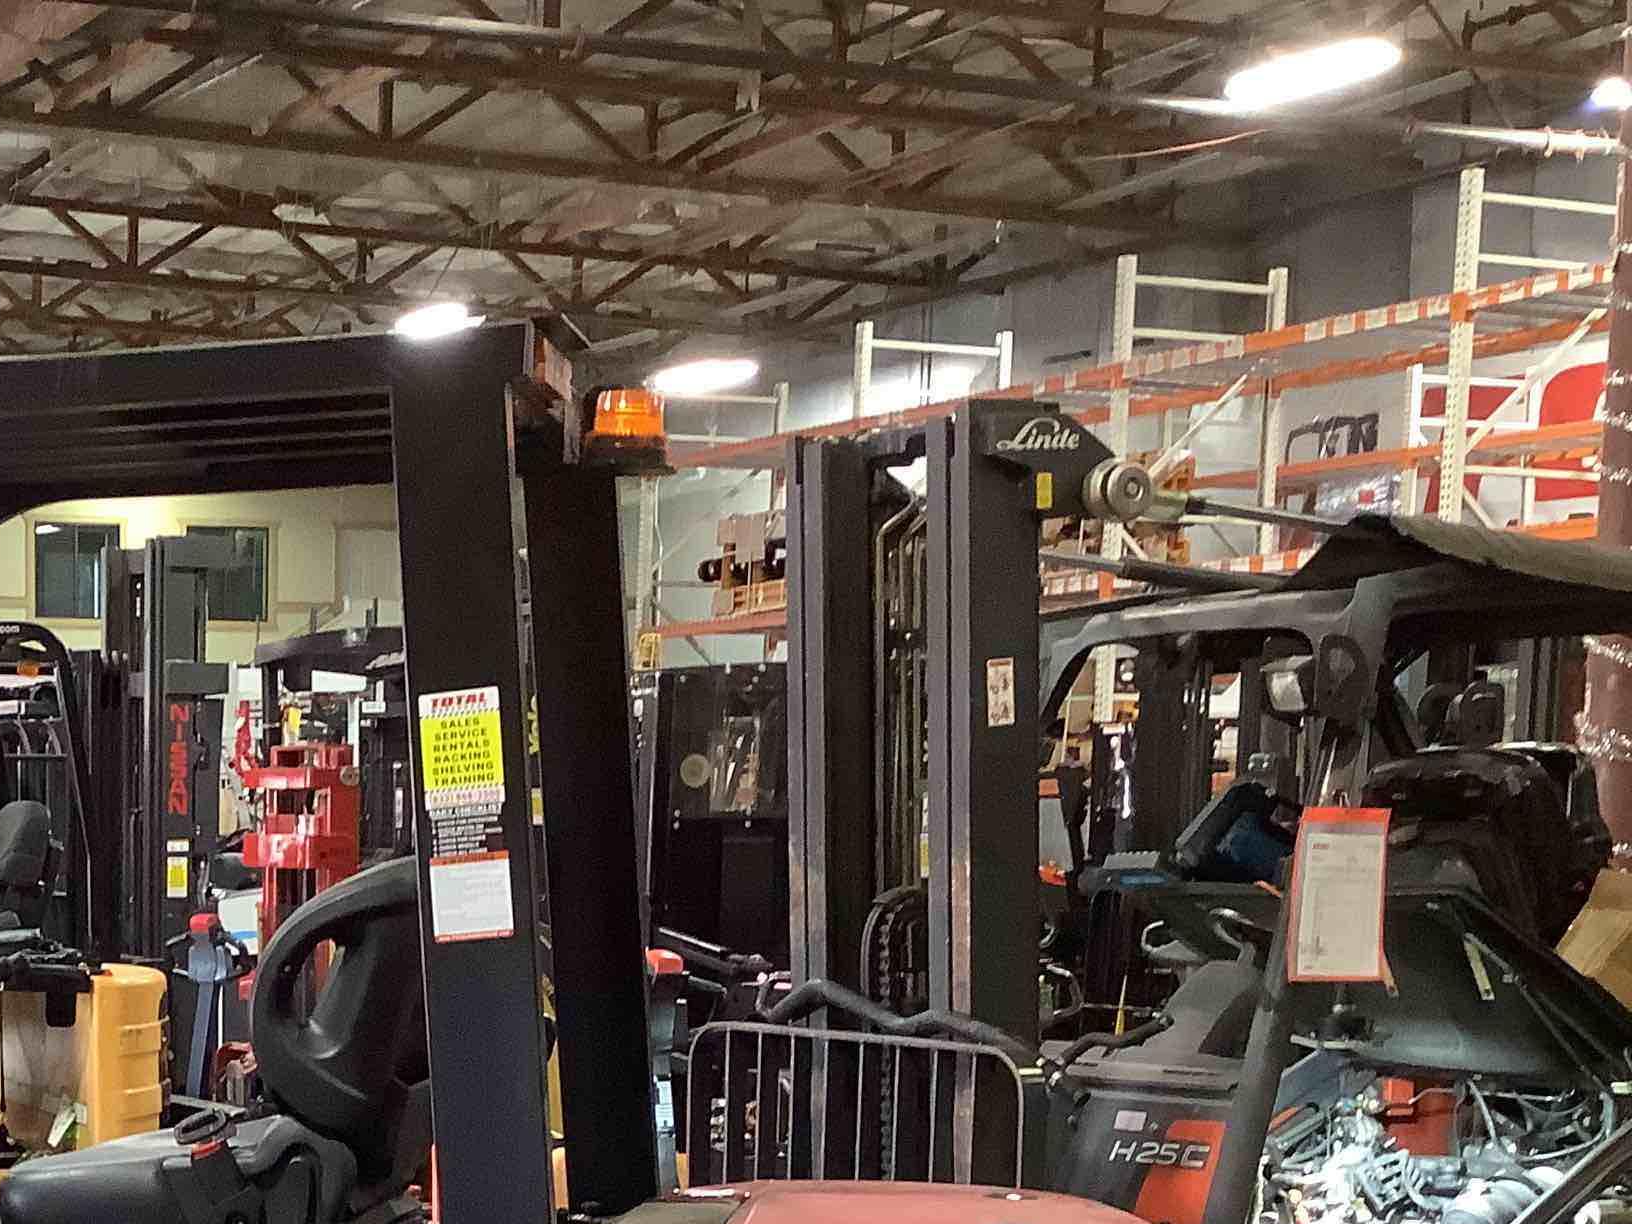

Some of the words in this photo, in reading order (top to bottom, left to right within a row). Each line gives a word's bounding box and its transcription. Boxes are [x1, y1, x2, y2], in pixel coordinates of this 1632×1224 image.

[996, 417, 1079, 451] Linde
[440, 717, 480, 729] SALES
[434, 728, 488, 741] SERVICE
[433, 739, 490, 752] RENTALS
[167, 703, 189, 815] NISSAN
[434, 750, 490, 763] RACKING
[432, 761, 494, 775] SHELVING
[434, 773, 494, 786] TRAINING
[1108, 1140, 1210, 1168] H25C
